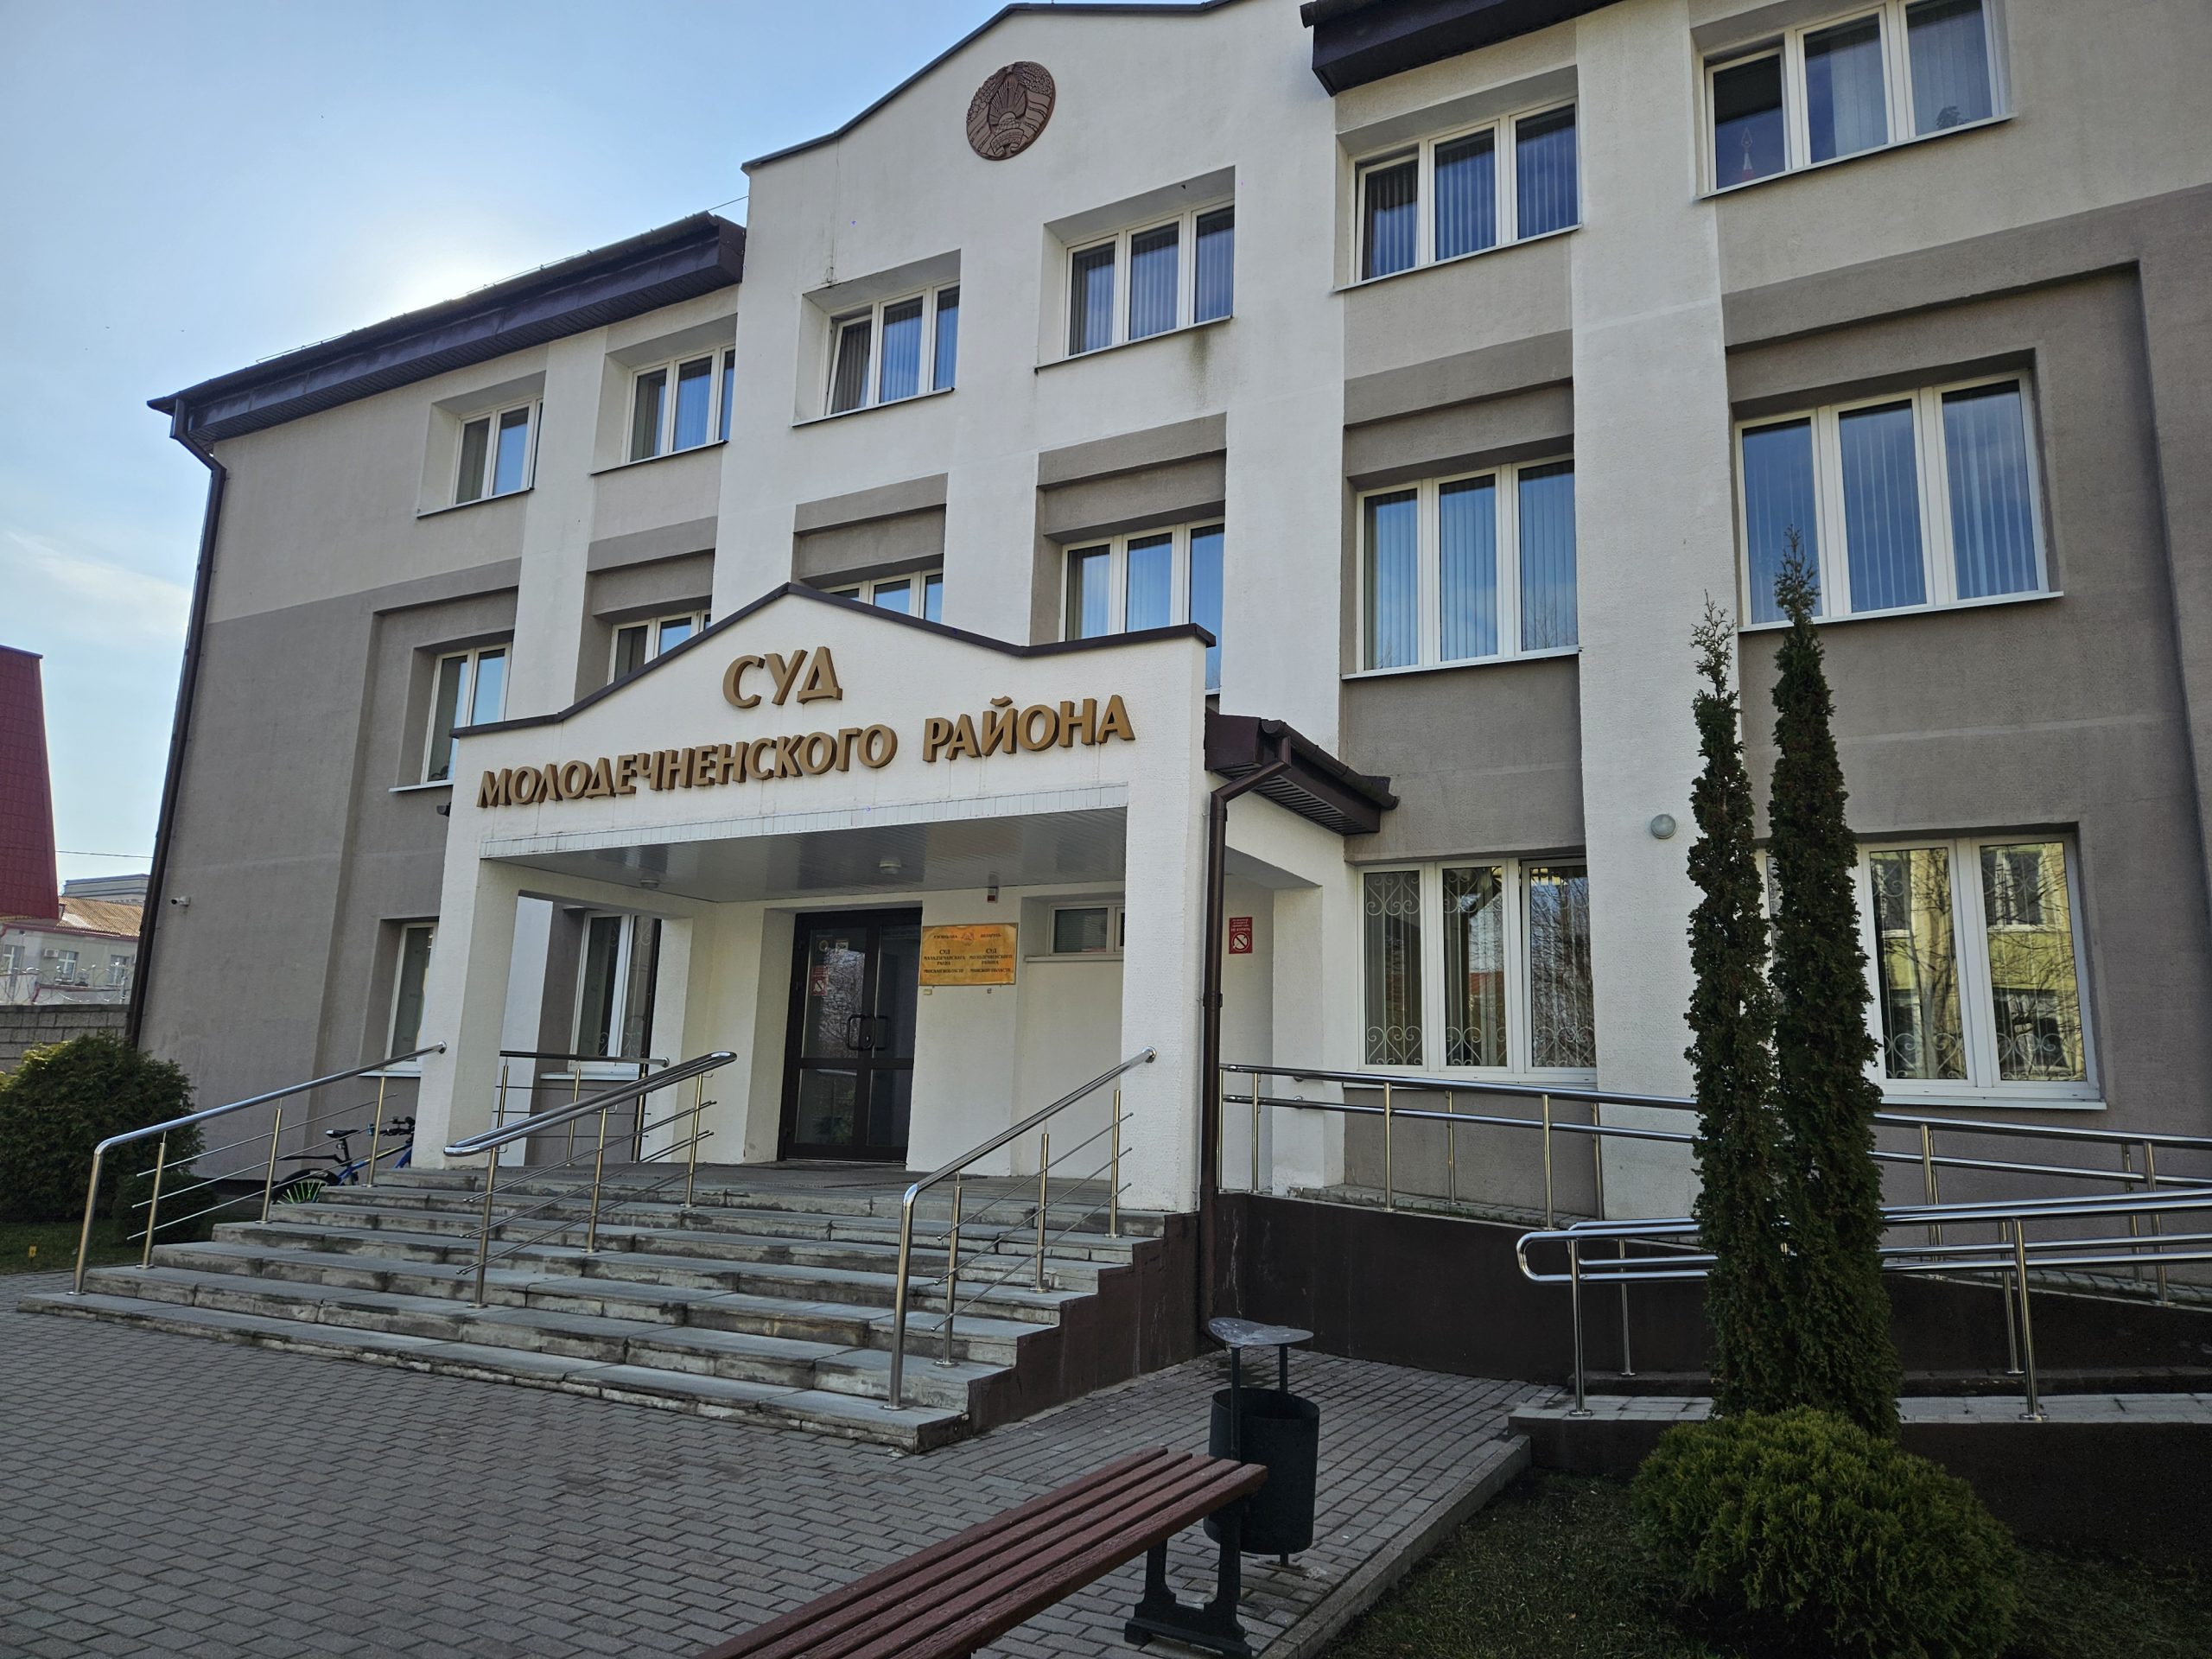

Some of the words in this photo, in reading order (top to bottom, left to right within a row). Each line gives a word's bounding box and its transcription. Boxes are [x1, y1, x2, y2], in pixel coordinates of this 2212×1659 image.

[722, 646, 842, 709] СУД
[476, 724, 898, 808] МОЛОДЕЧНЕНСКОГО
[923, 695, 1135, 762] РАЙОНА
